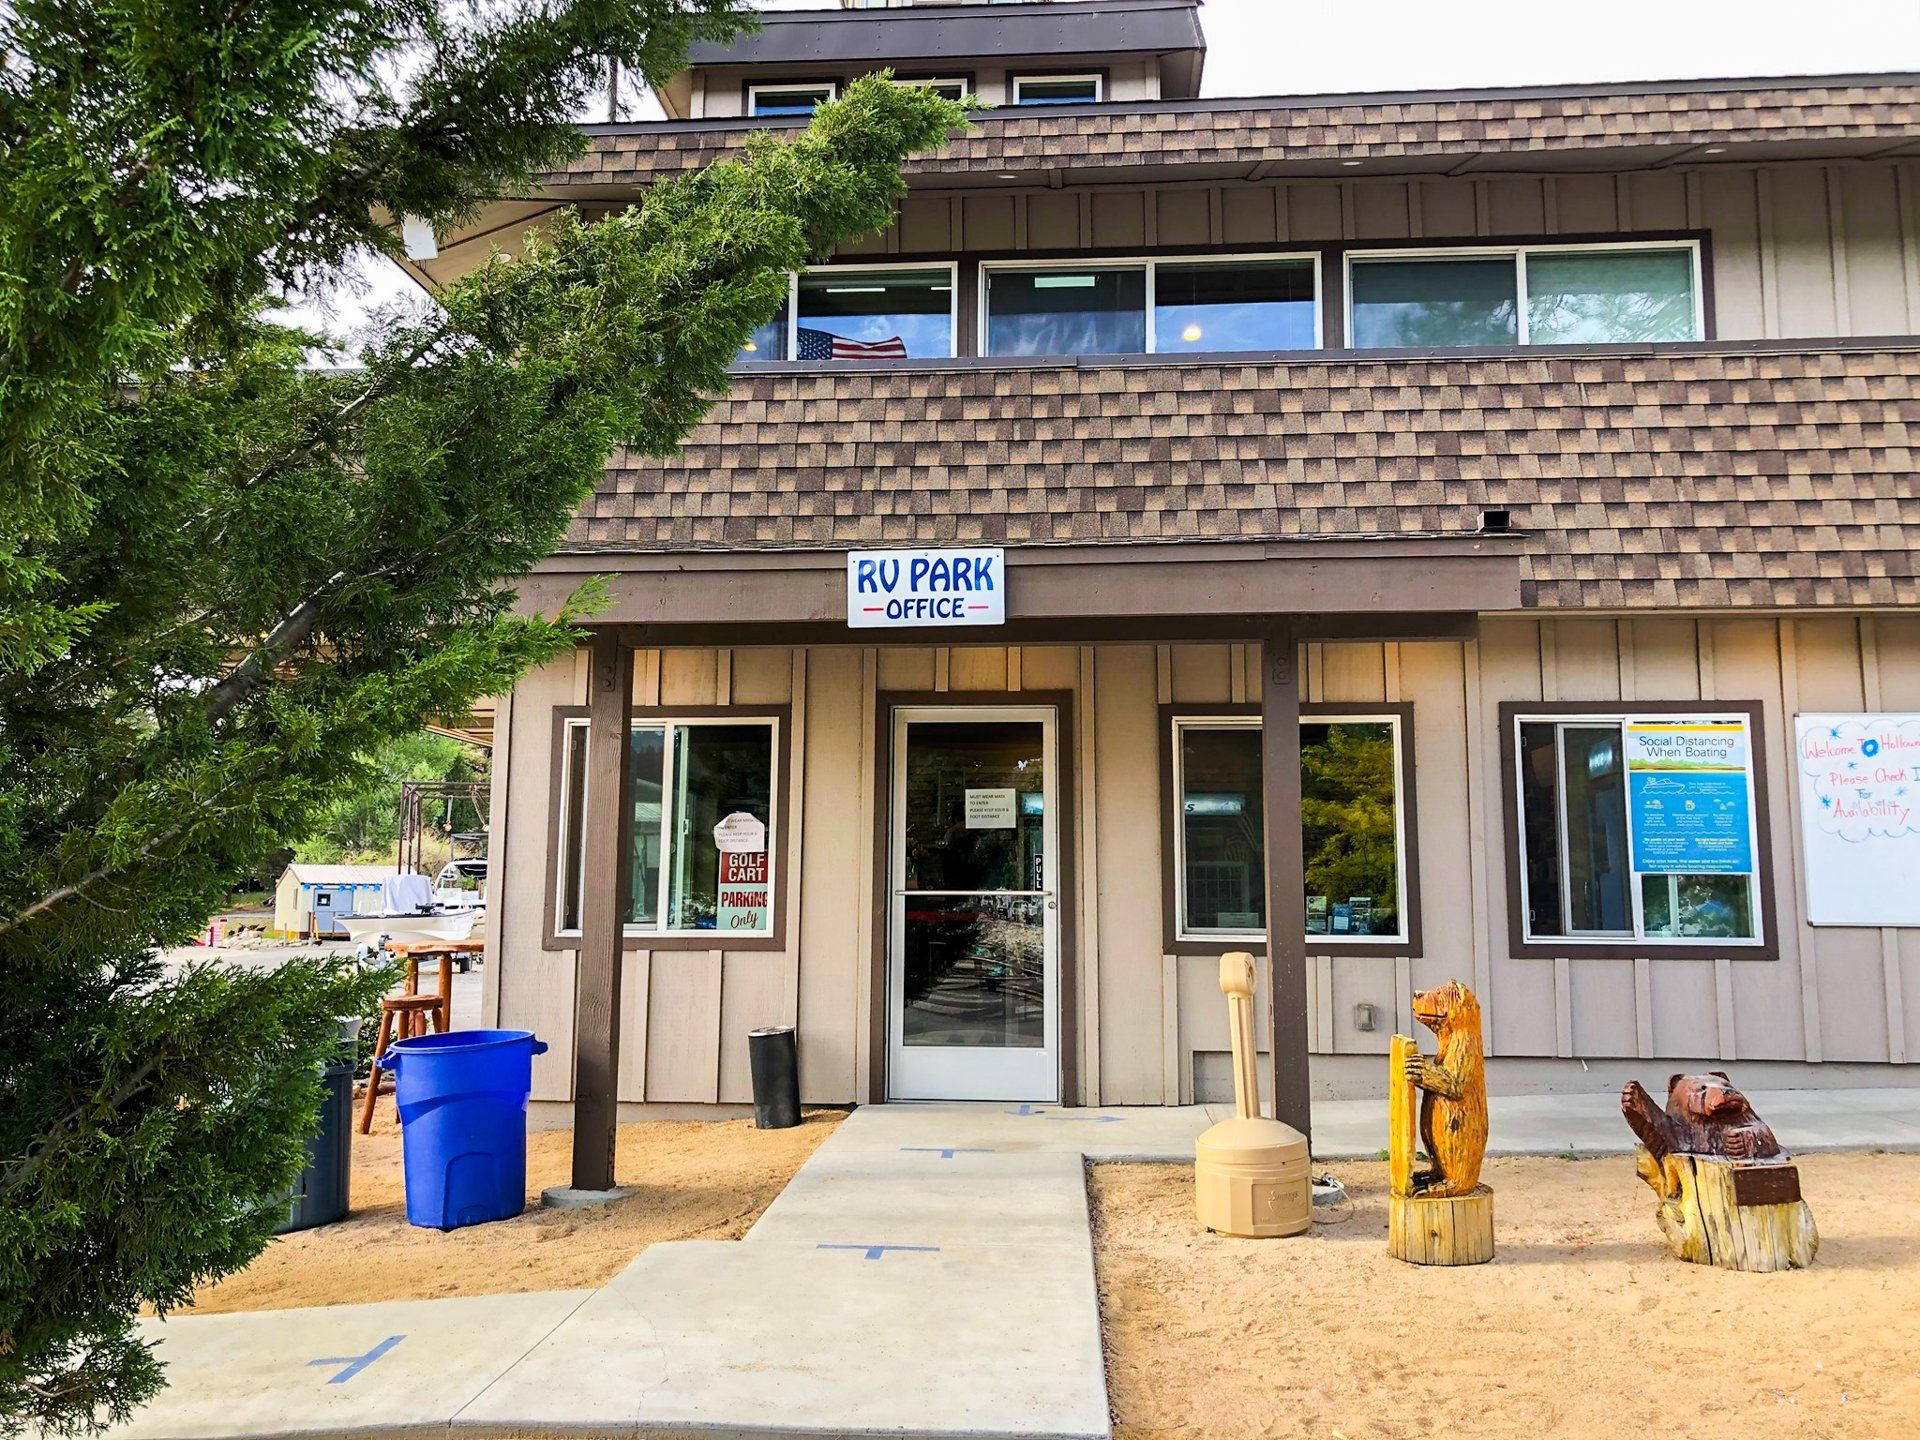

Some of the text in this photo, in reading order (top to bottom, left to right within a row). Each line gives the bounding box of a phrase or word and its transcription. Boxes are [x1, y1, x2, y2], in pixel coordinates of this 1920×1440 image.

[858, 557, 994, 593] RV PARK
[886, 597, 966, 620] OFFICE
[1639, 735, 1735, 748] Social Distancing
[1804, 739, 1857, 759] Welcome
[1646, 747, 1727, 759] When Boating
[1829, 771, 1869, 787] Please
[1875, 767, 1907, 784] Check
[1855, 788, 1872, 799] For
[1833, 798, 1910, 826] Availability
[728, 853, 764, 868] GOLF
[728, 867, 764, 882] CART
[721, 891, 768, 908] PARKING
[730, 910, 758, 929] Only
